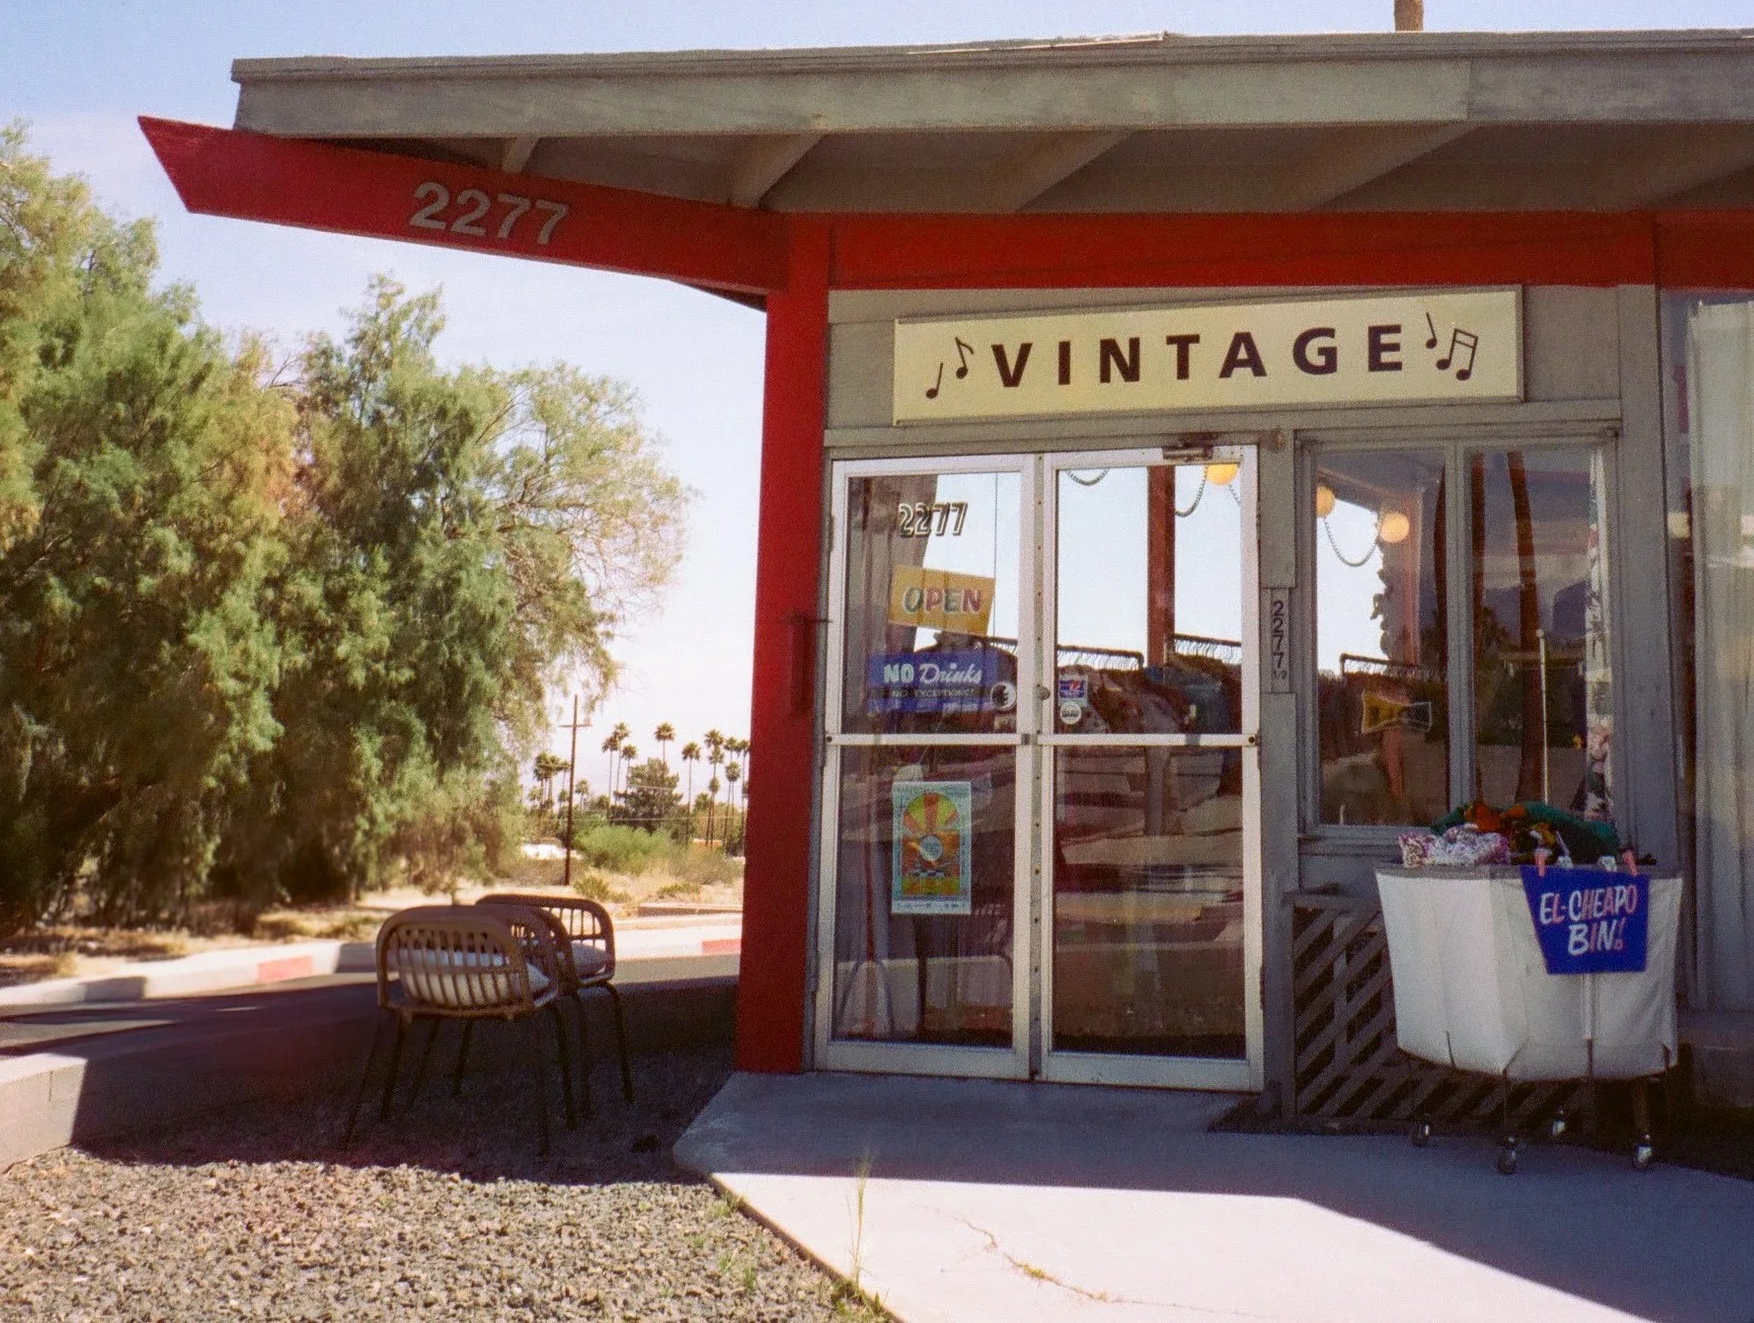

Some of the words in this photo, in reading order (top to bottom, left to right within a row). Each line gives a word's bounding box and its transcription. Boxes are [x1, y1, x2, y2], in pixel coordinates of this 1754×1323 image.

[409, 182, 569, 245] 2277
[992, 325, 1403, 388] VINTAGE
[898, 501, 968, 537] 2277
[903, 587, 982, 614] OPEN
[1272, 600, 1285, 669] 2277
[884, 663, 914, 684] NO
[919, 663, 982, 684] Drinks
[891, 689, 909, 698] NO
[1568, 917, 1626, 956] BIN!
